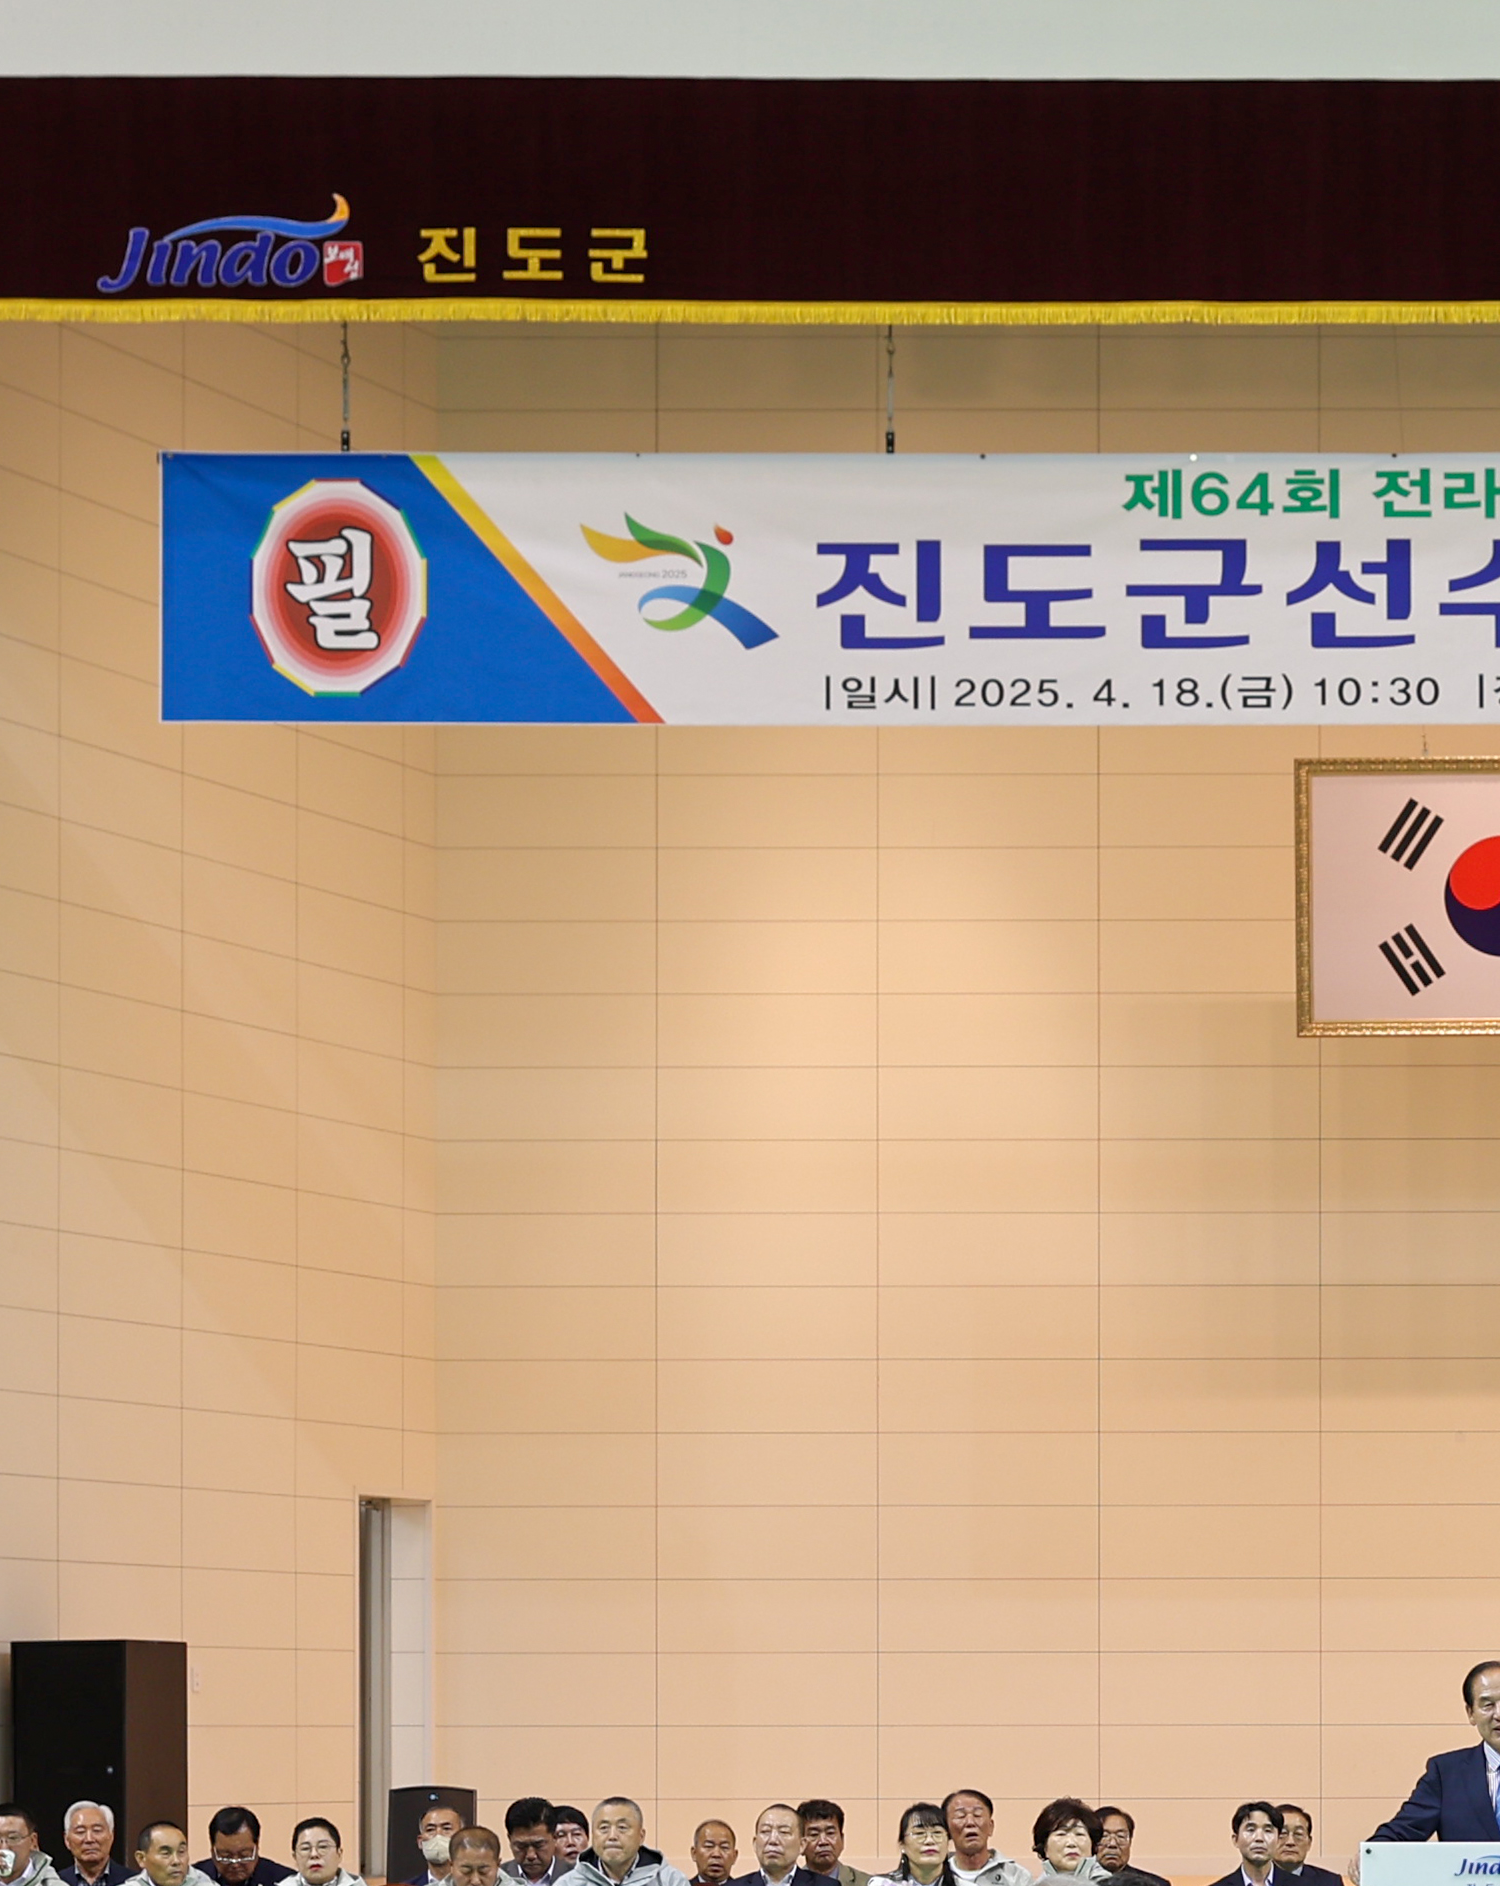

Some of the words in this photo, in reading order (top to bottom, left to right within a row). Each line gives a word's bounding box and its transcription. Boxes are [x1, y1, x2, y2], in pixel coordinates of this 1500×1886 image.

[97, 227, 320, 293] Jindo
[417, 226, 649, 284] 진도군
[1123, 468, 1342, 521] 제64회
[285, 525, 381, 651] 필
[662, 570, 688, 579] 2025
[954, 678, 1075, 711] 2025.
[1093, 678, 1131, 711] 4.
[1152, 674, 1295, 712] 18.(금)
[1315, 677, 1442, 708] 10:30
